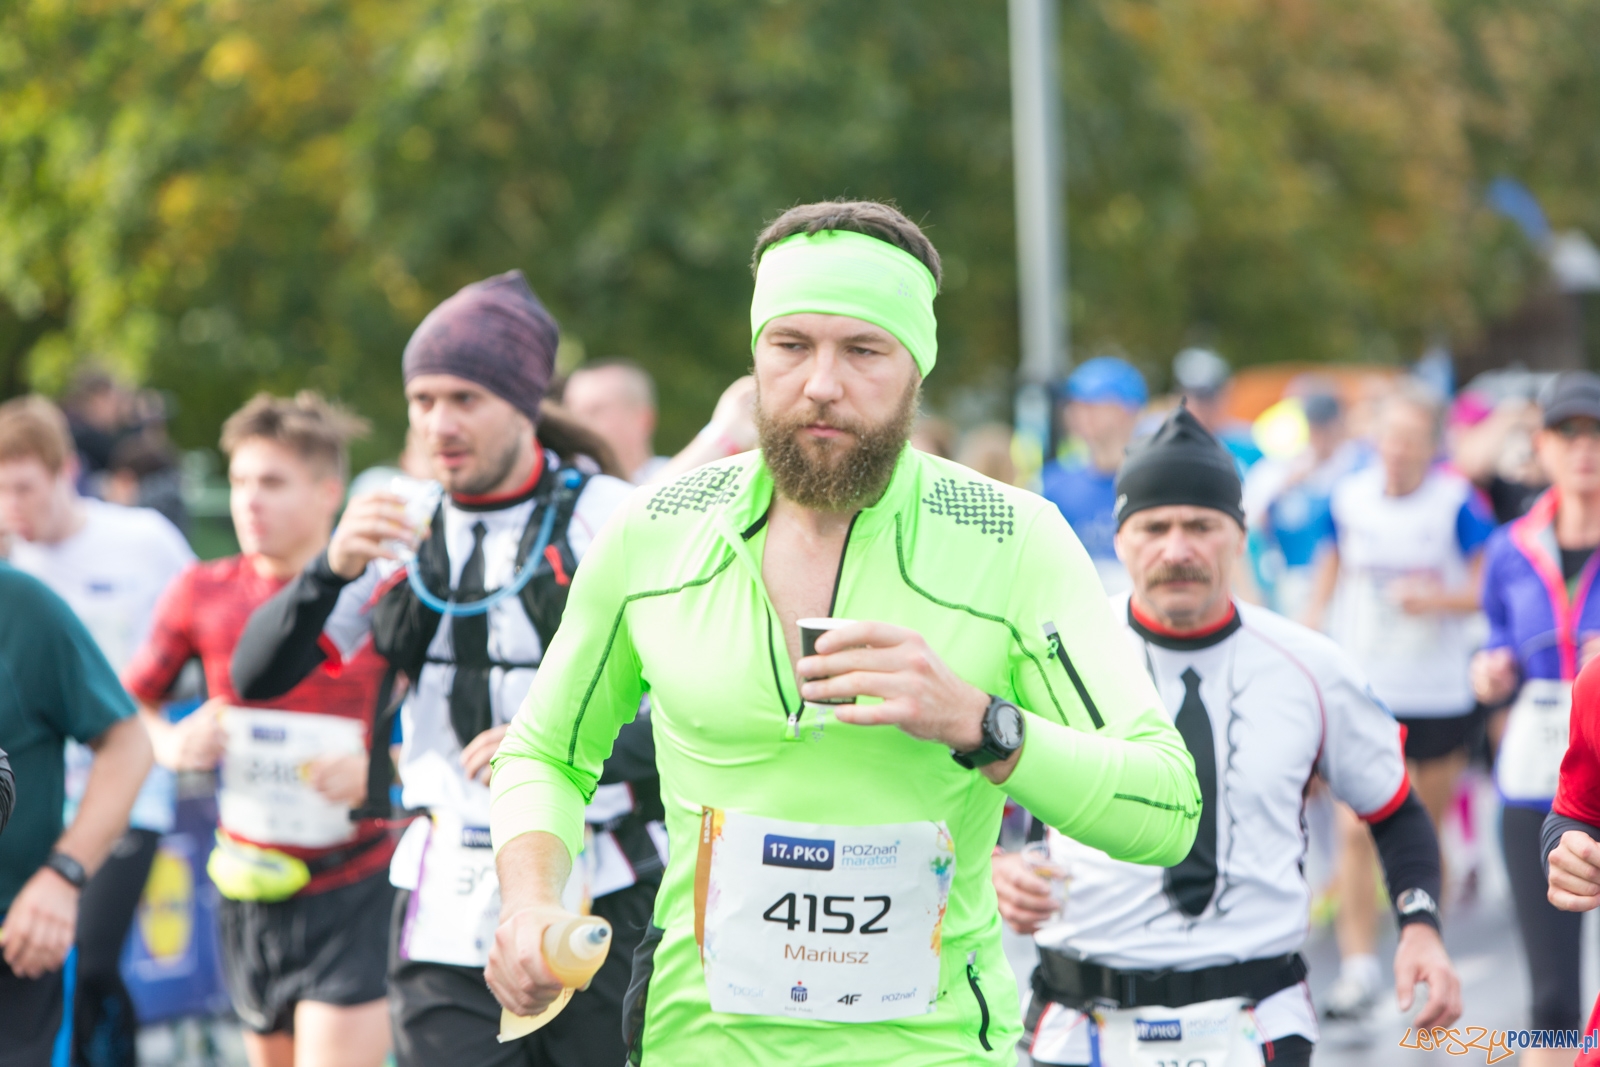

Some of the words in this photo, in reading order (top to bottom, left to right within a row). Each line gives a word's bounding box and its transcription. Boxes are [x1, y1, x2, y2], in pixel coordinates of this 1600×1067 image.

[841, 854, 898, 867] maraton
[762, 892, 892, 935] 4152
[784, 944, 870, 965] Mariusz
